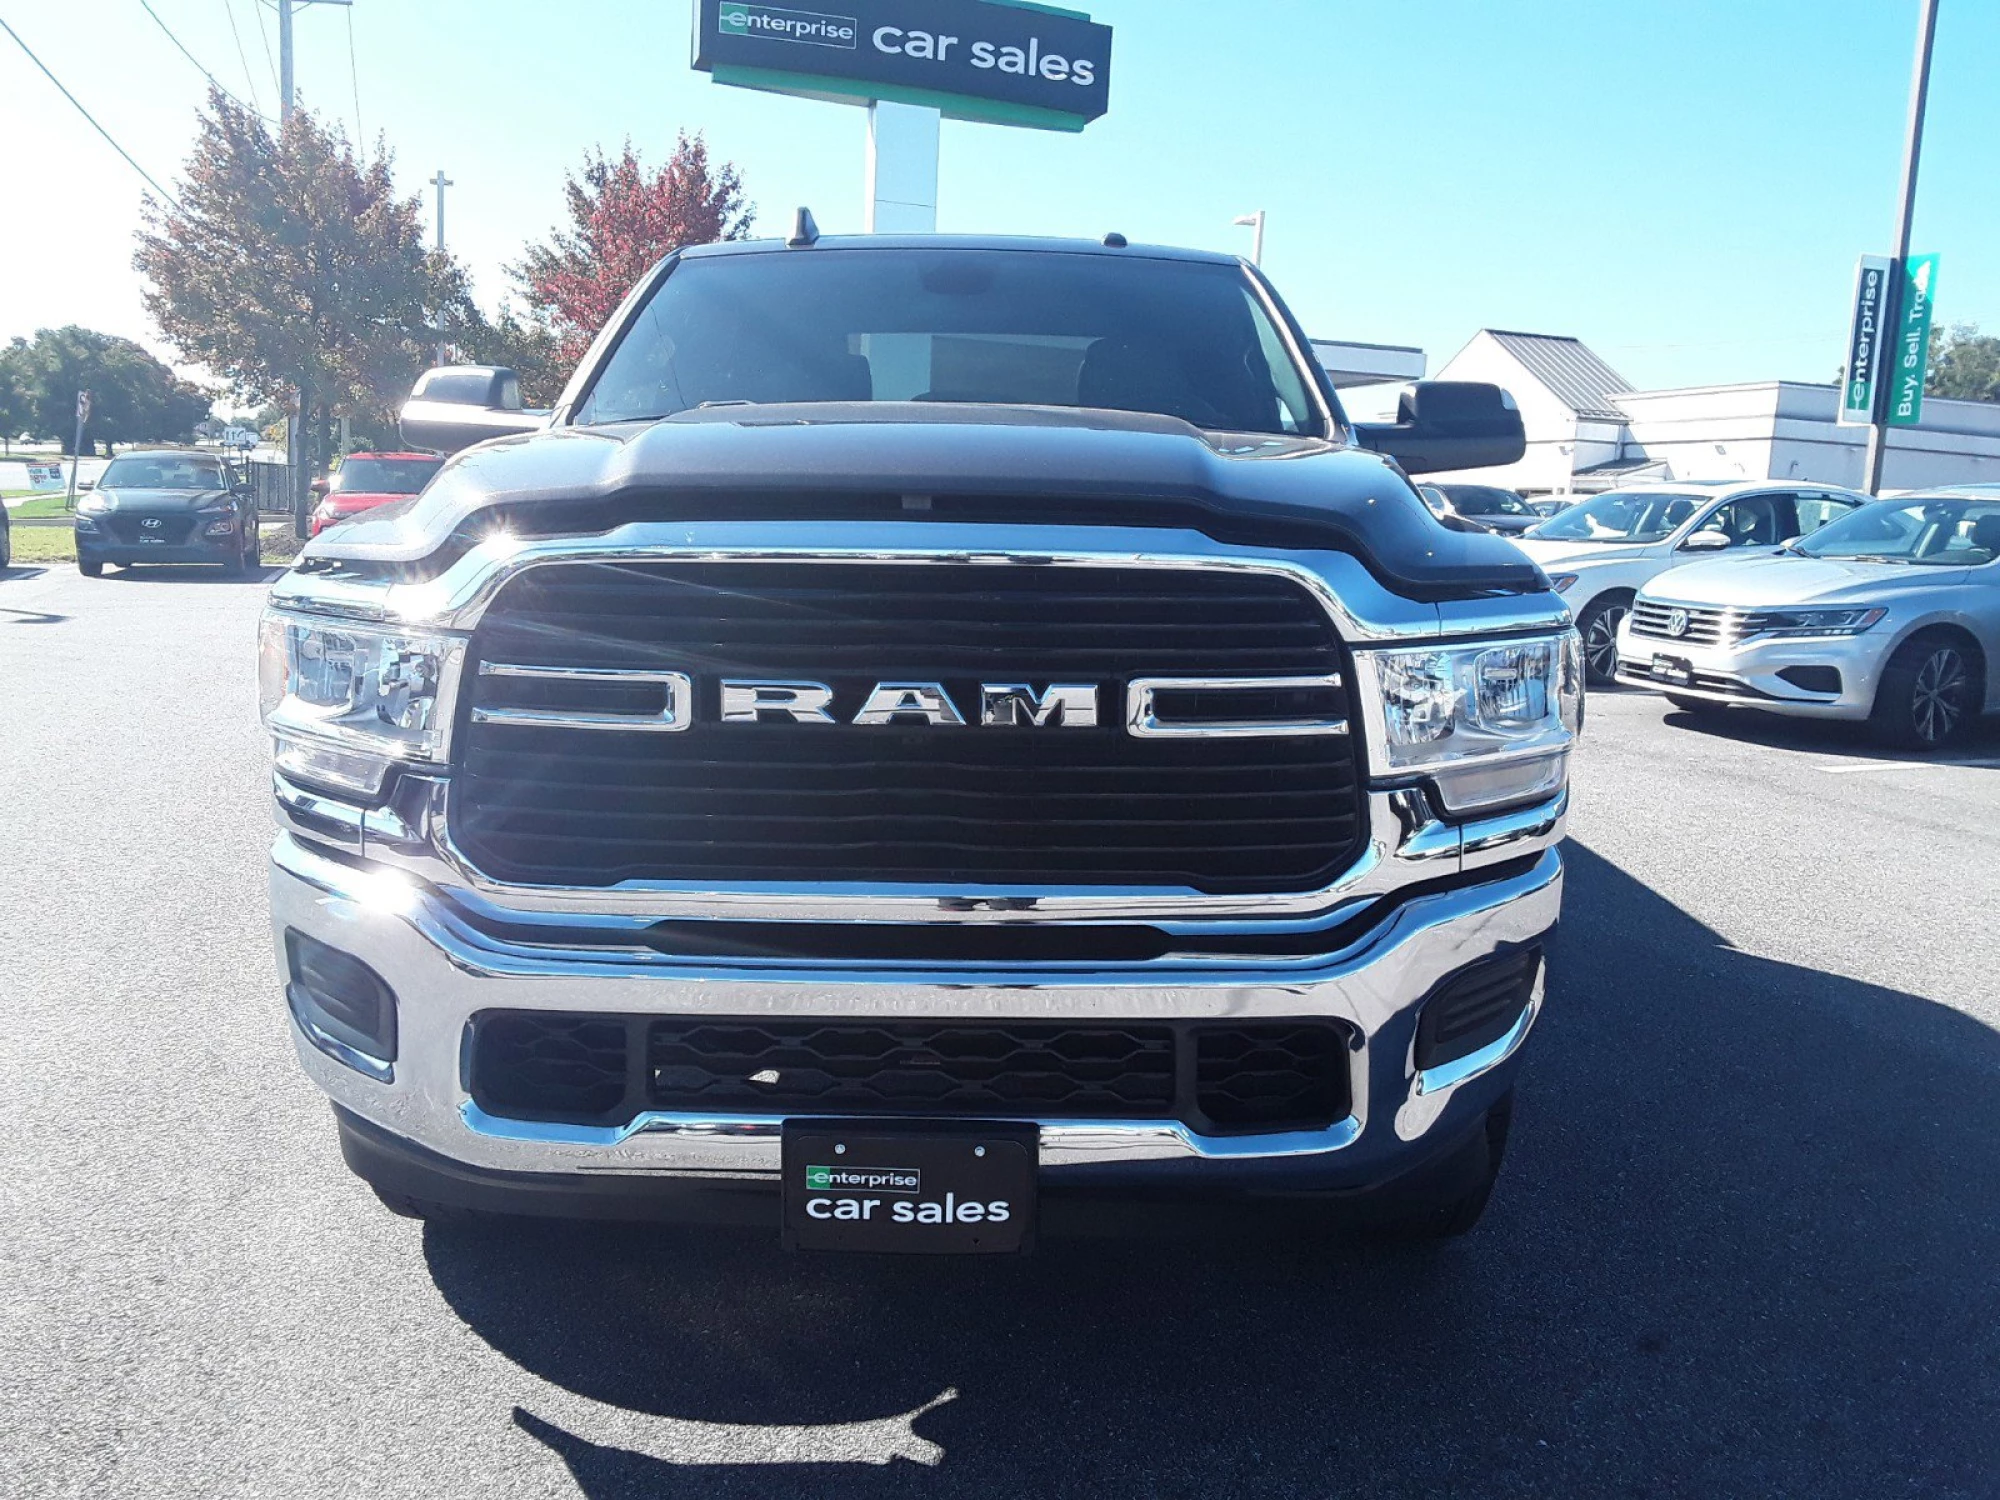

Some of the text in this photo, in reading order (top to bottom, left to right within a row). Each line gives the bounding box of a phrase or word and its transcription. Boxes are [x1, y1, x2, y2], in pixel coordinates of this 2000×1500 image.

[727, 9, 854, 40] enterprise
[872, 25, 1096, 86] car sales
[1853, 270, 1879, 404] enterprise
[720, 678, 1098, 726] RAM
[813, 1171, 917, 1187] enterprise
[806, 1192, 1011, 1224] car sales
